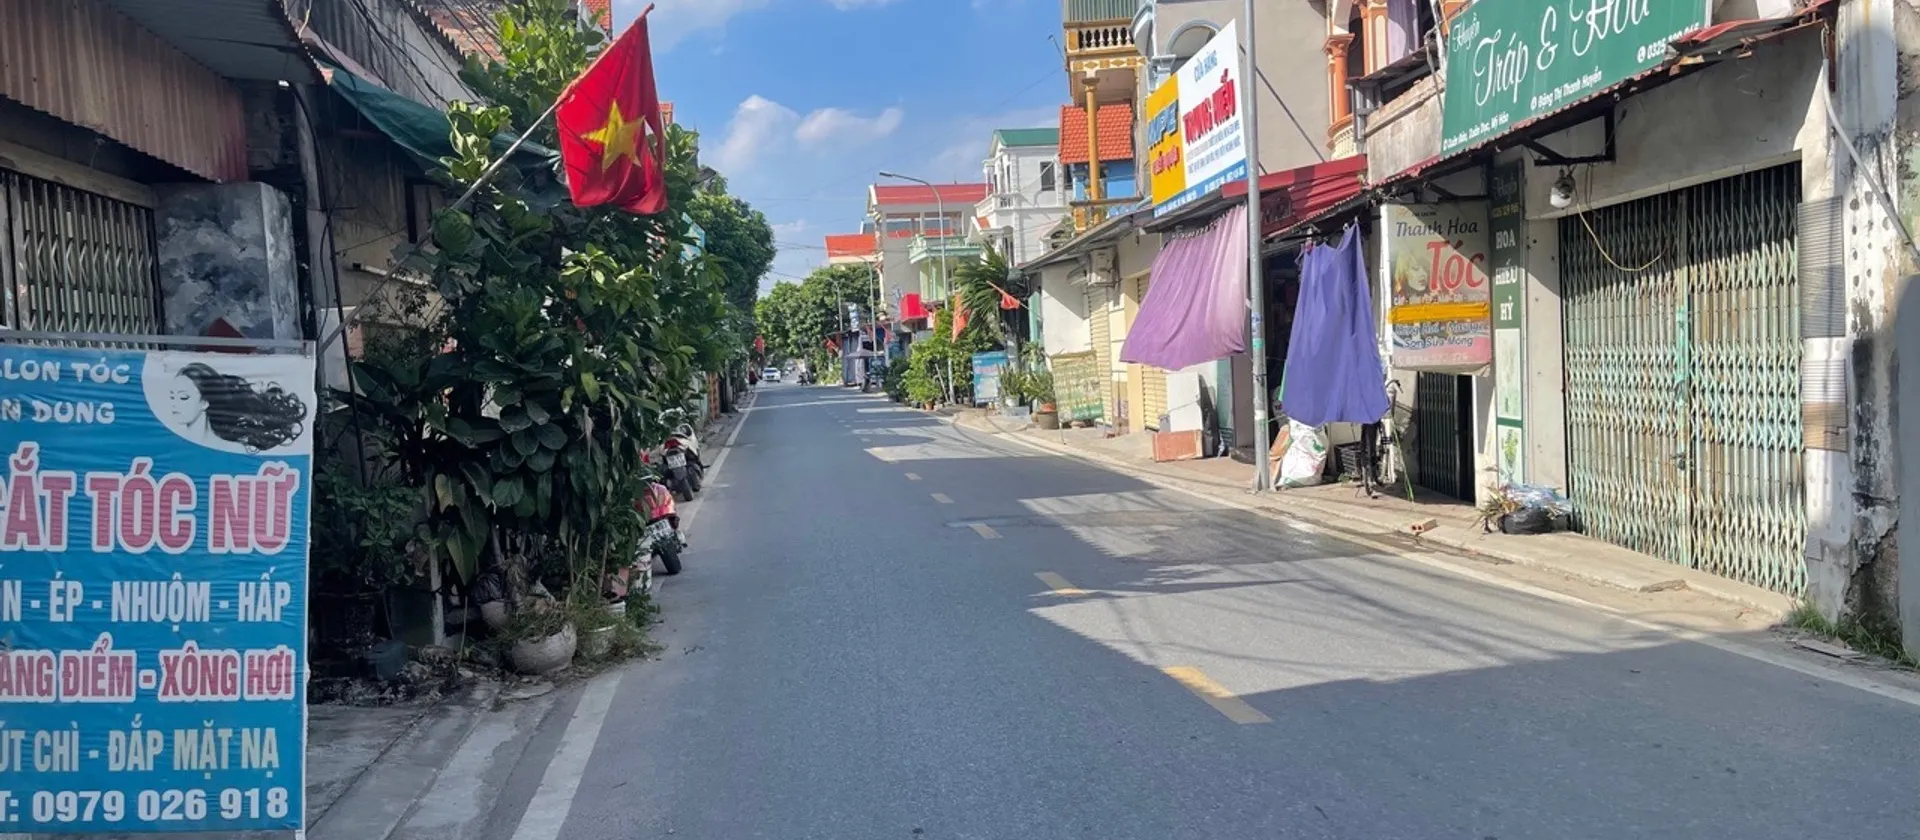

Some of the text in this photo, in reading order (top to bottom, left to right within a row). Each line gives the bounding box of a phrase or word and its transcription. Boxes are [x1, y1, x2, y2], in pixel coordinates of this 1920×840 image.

[1474, 29, 1529, 106] Tráp
[1396, 217, 1478, 237] Thanh Hoa
[1496, 229, 1516, 250] HOA
[1427, 240, 1485, 291] Tóc
[0, 357, 130, 384] LON TÓC
[32, 399, 115, 424] DUNG
[0, 443, 298, 552] ẮT TÓC NỮ
[50, 571, 83, 622] ÉP
[111, 572, 210, 632] NHUỘM
[238, 566, 291, 622] HẤP
[61, 634, 135, 699] ĐIỂM
[160, 643, 239, 698] XÔNG
[246, 649, 294, 697] HƠI
[34, 720, 79, 772] CHÌ
[108, 713, 163, 772] ĐẮP
[173, 719, 232, 780] MẶT
[241, 727, 279, 779] NẠ
[32, 790, 125, 822] 0979
[138, 789, 207, 821] 026
[220, 787, 288, 820] 918
